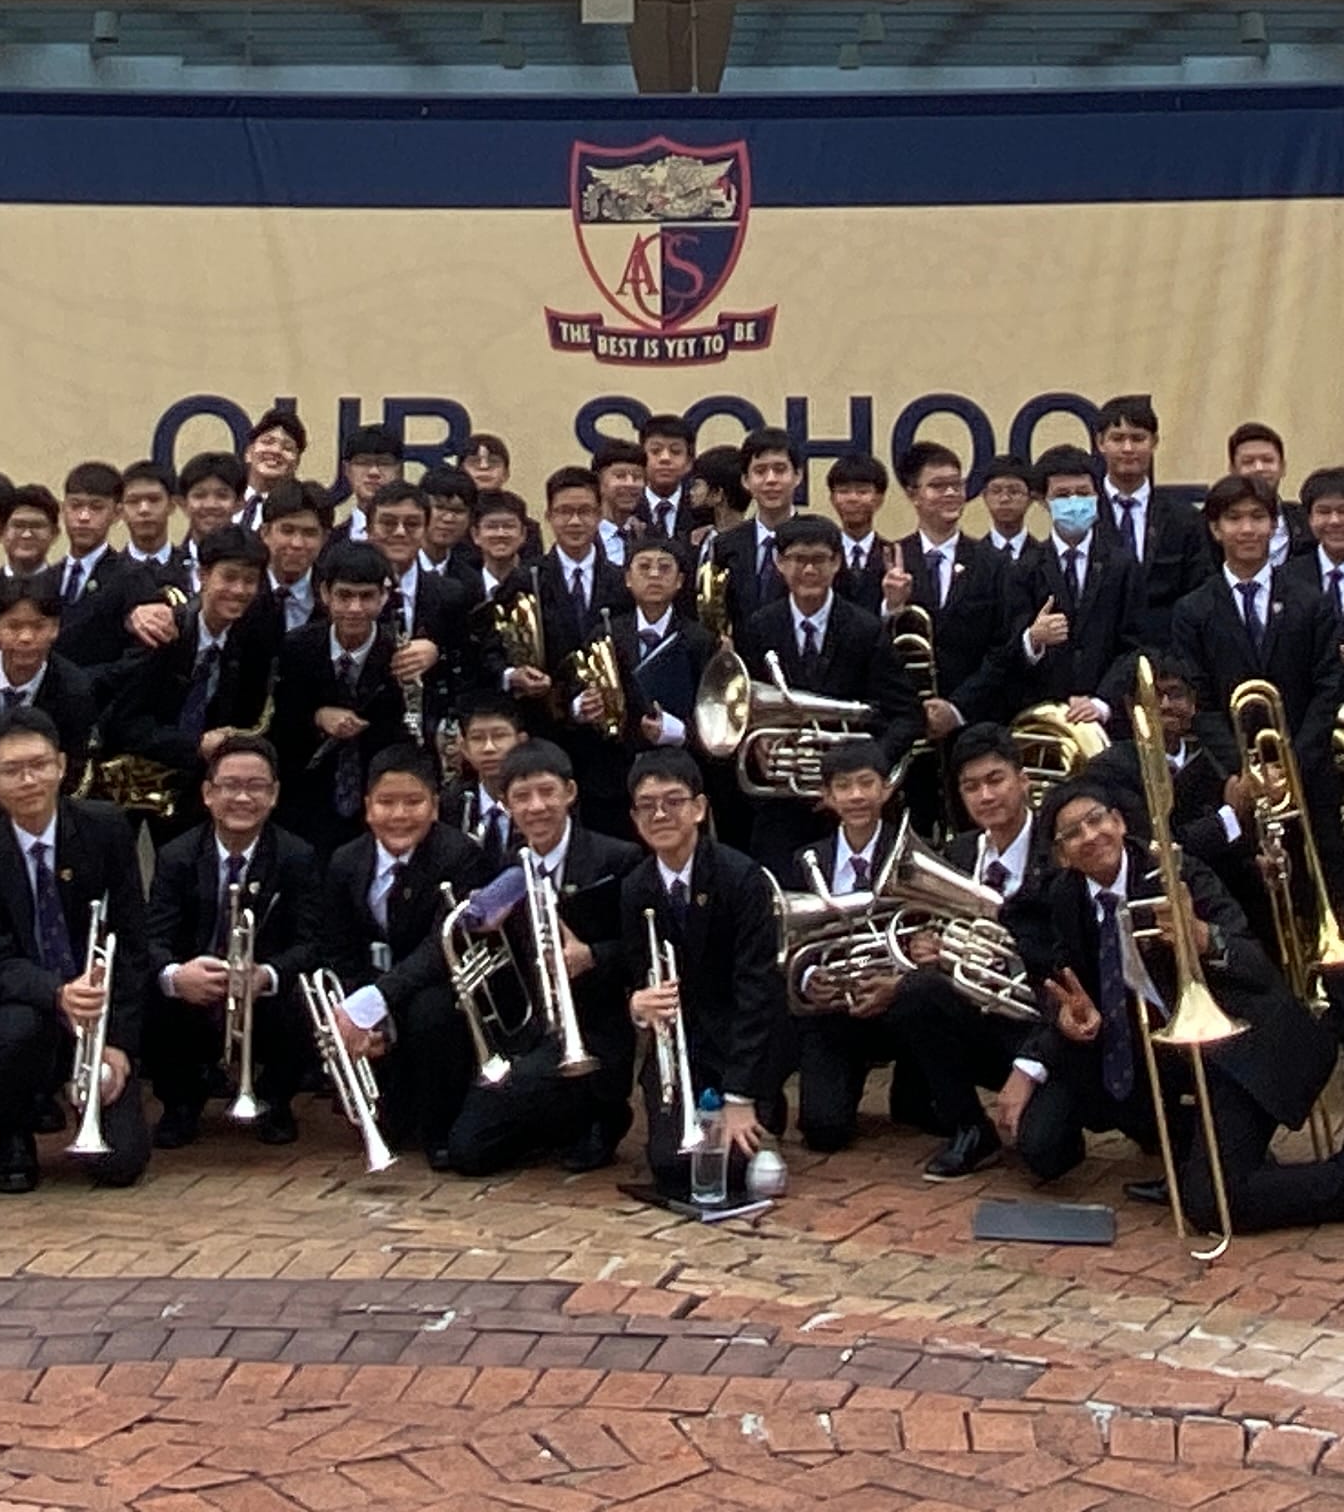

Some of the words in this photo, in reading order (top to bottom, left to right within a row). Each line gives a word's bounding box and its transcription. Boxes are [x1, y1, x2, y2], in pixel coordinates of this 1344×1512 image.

[559, 322, 590, 343] THE
[597, 336, 637, 356] BEST
[644, 338, 659, 357] IS
[665, 337, 695, 357] YET
[704, 335, 725, 353] TO
[734, 322, 756, 341] BE
